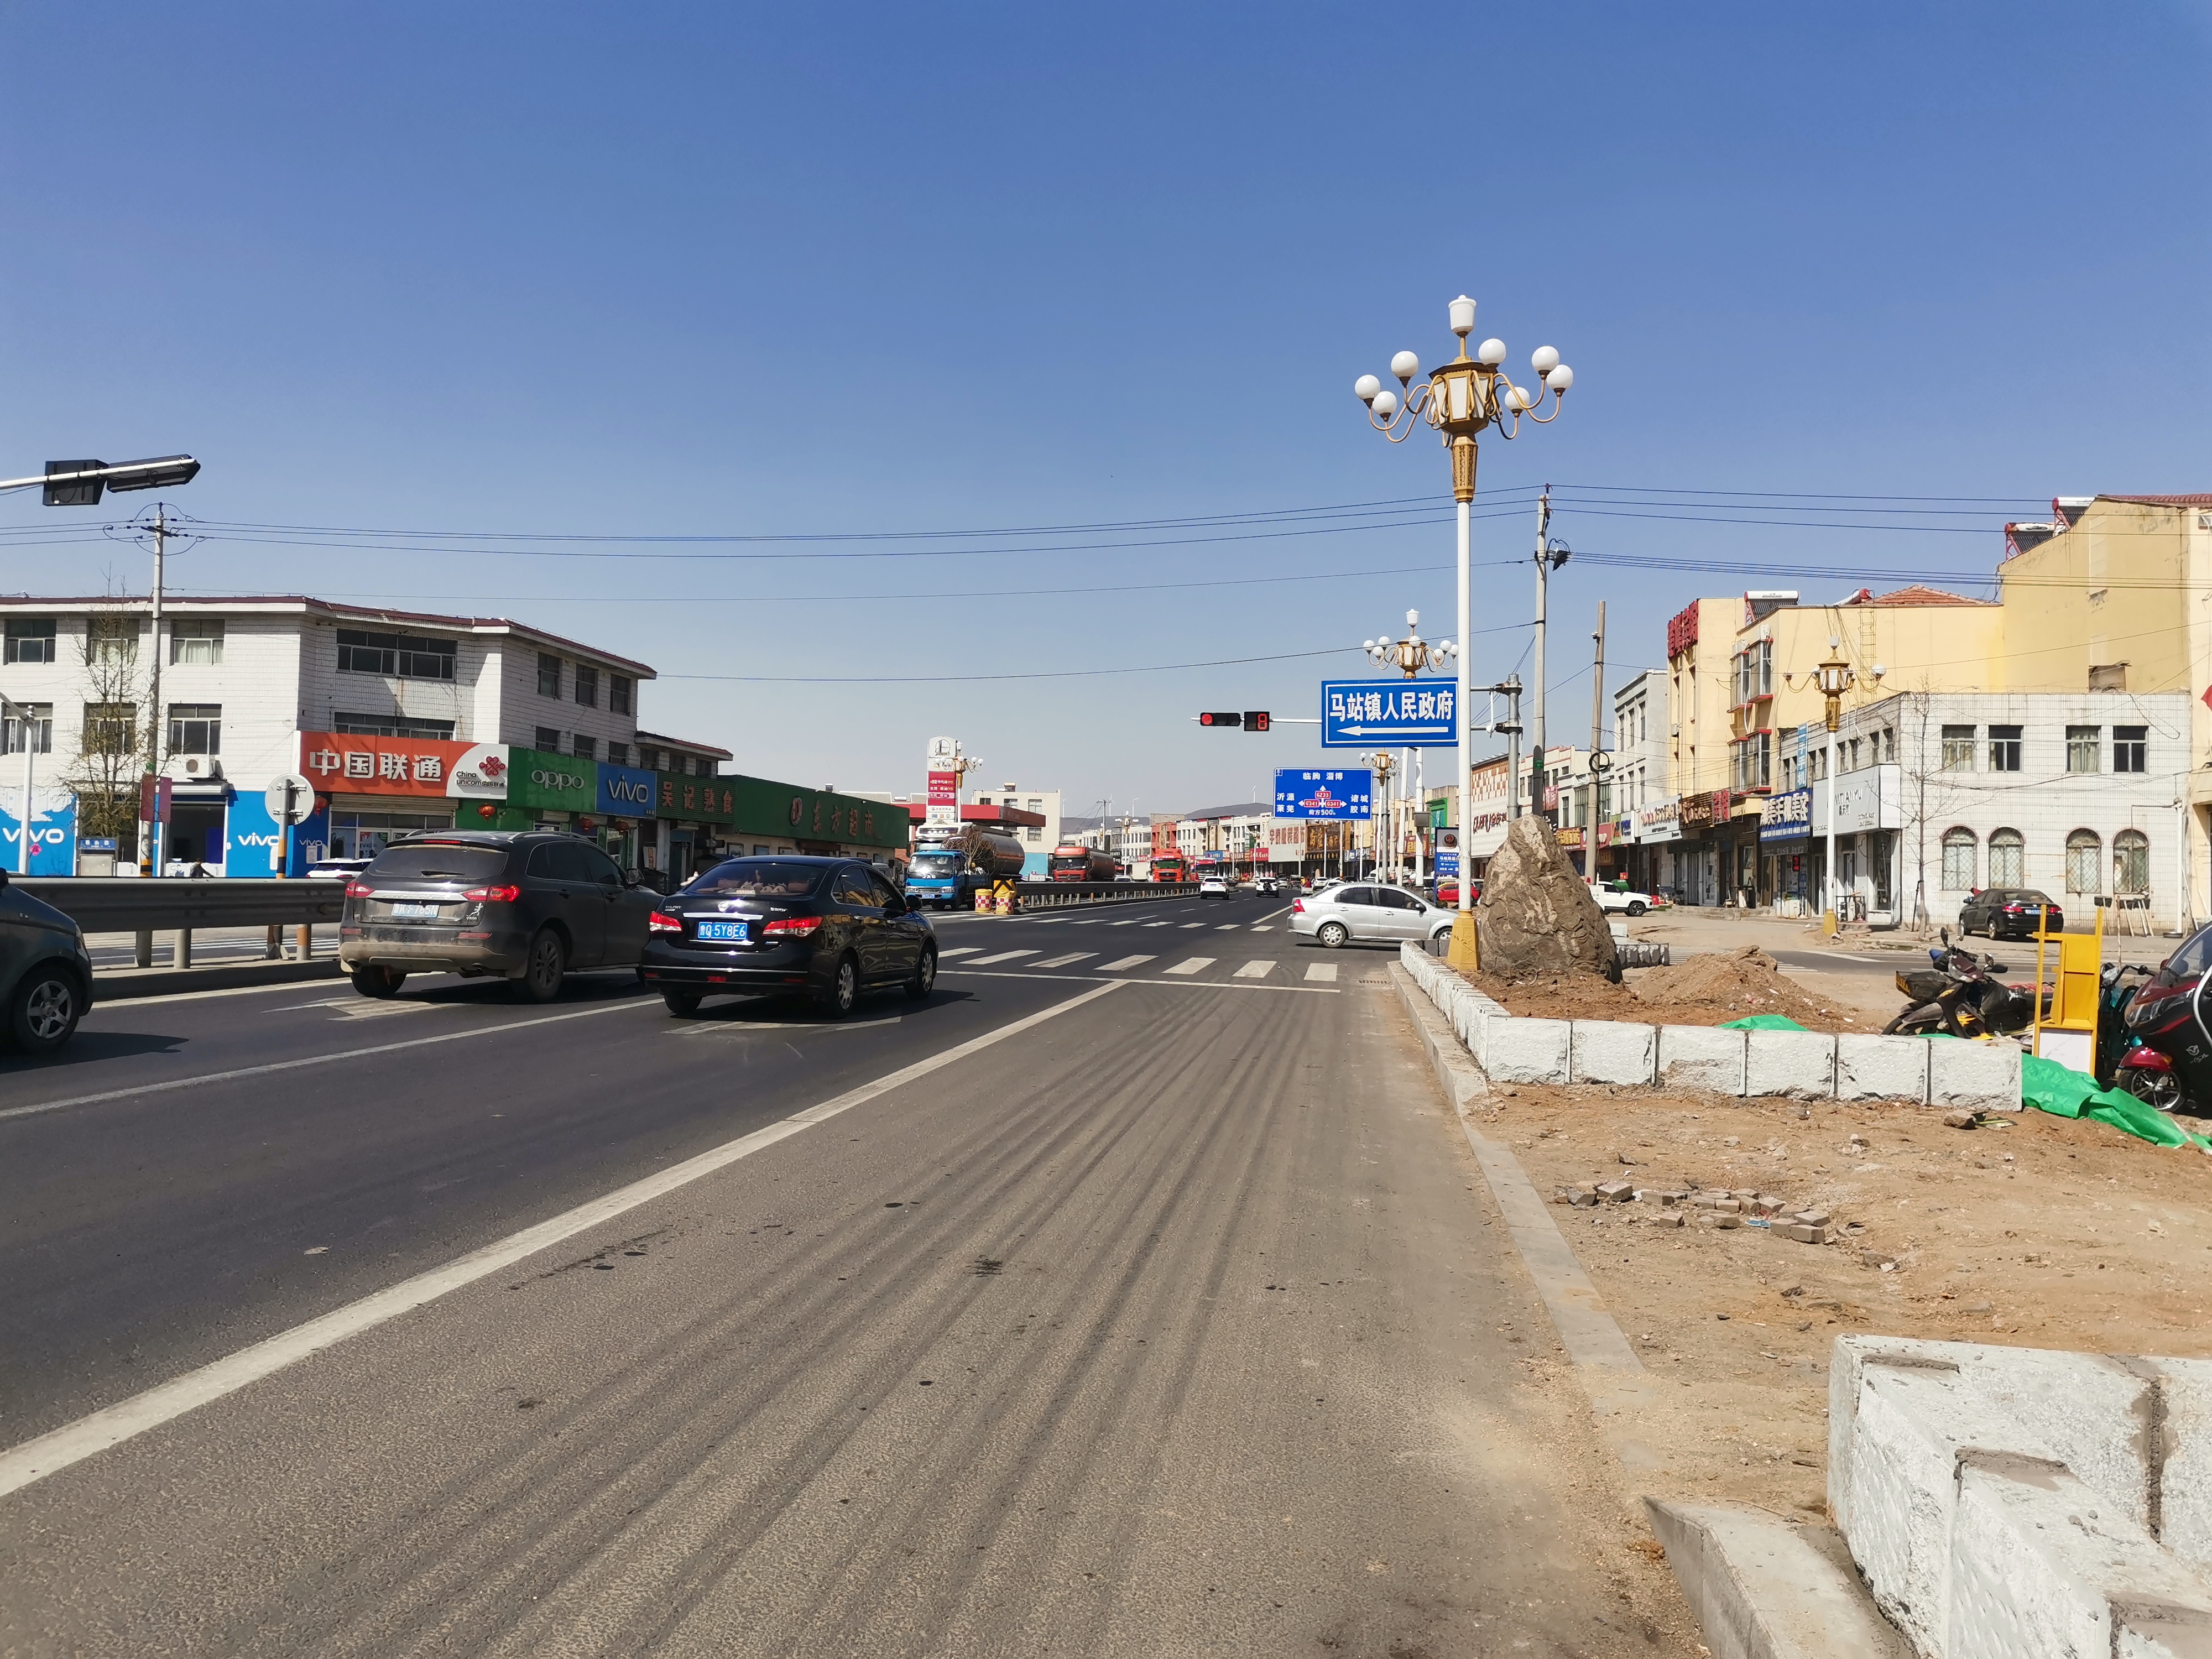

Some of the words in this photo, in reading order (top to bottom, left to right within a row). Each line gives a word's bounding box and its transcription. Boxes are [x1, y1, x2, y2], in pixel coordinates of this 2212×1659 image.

[1330, 690, 1454, 722] 马站镇人民政府
[1258, 713, 1267, 730] 8
[309, 749, 441, 782] 中国联通
[608, 774, 649, 804] vivo
[1276, 792, 1295, 801] 沂源
[1350, 794, 1369, 803] 诸城
[1276, 805, 1295, 813] 莱芜
[1350, 805, 1369, 814] 胶南
[2, 828, 64, 843] vvo
[299, 837, 323, 847] vivo
